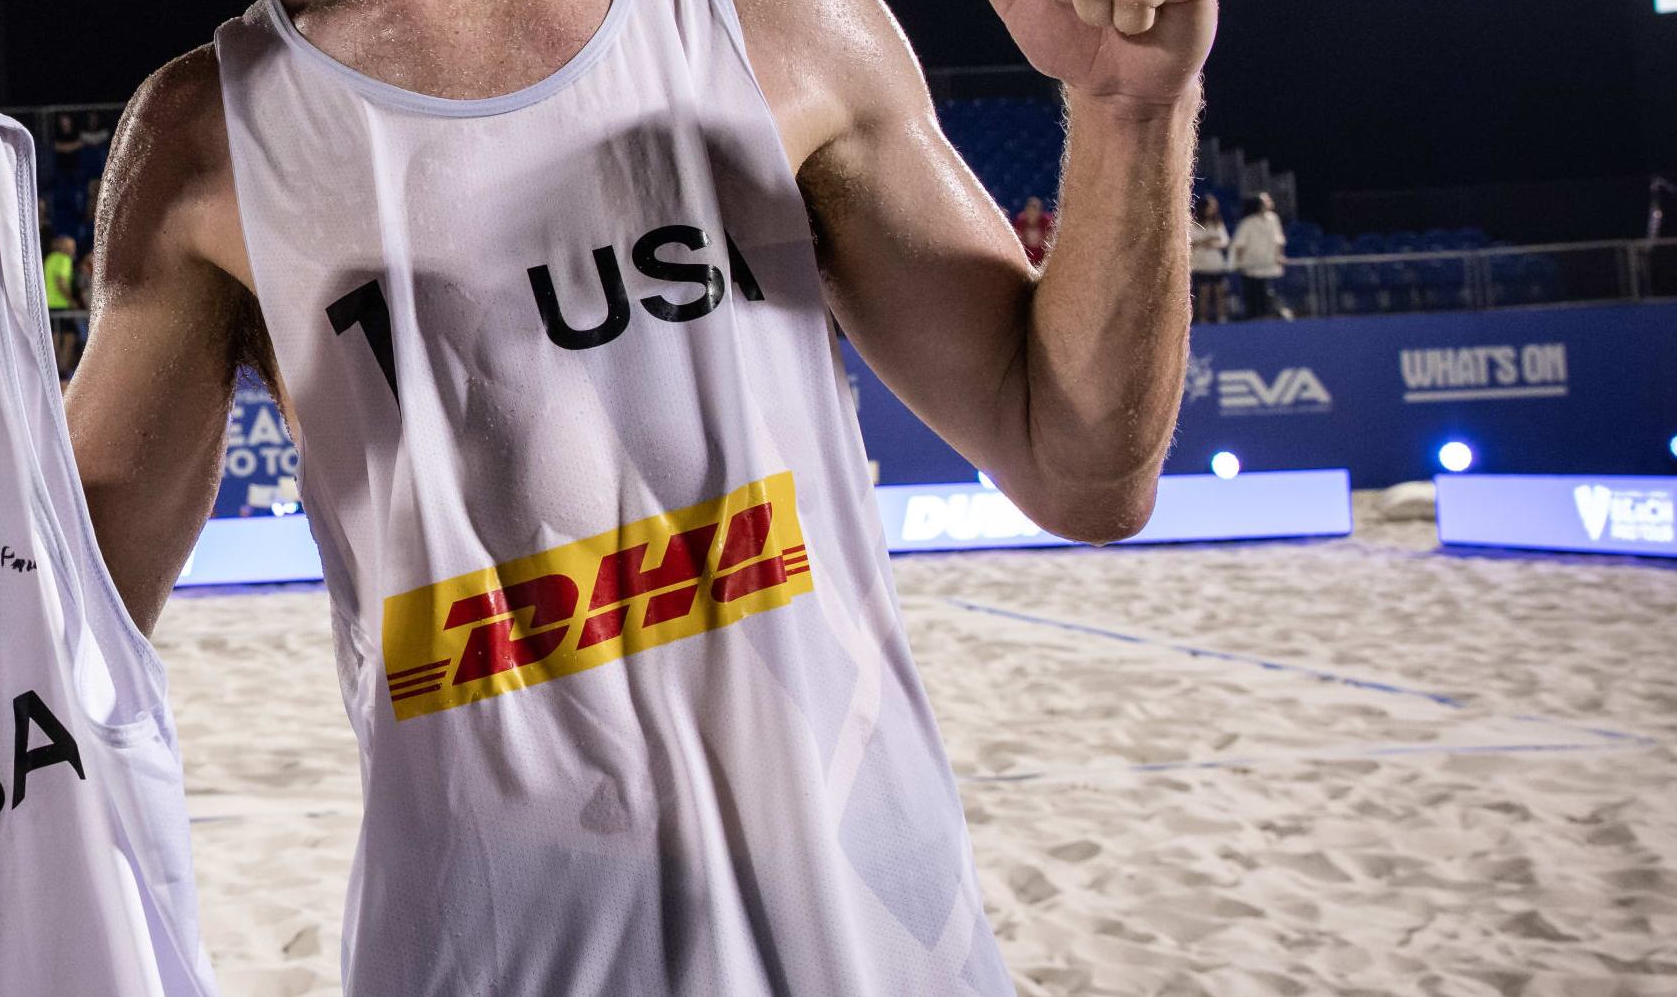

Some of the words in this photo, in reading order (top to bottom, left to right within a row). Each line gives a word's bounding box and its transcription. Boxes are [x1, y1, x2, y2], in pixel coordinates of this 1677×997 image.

[1218, 368, 1332, 406] EVA
[1401, 345, 1519, 388] WHAT'S
[1522, 343, 1568, 383] ON
[443, 502, 787, 686] DHL
